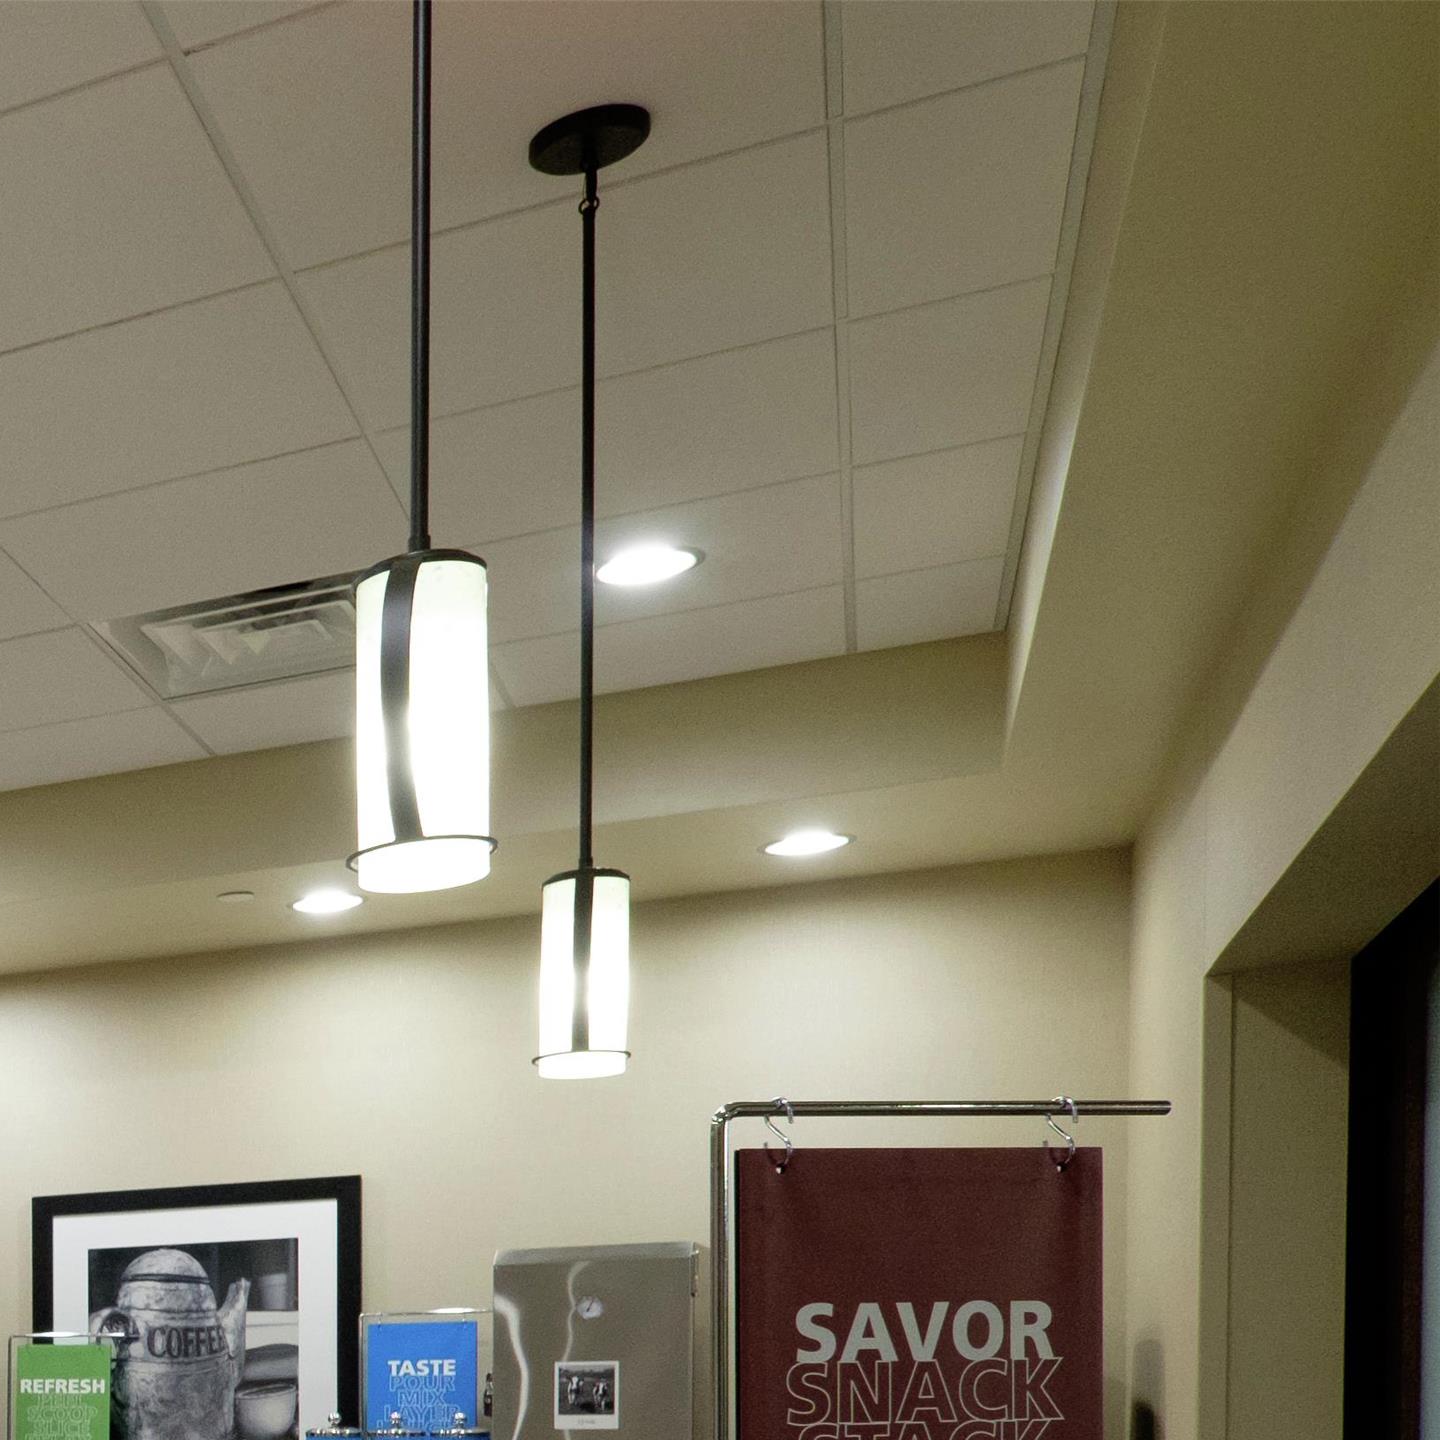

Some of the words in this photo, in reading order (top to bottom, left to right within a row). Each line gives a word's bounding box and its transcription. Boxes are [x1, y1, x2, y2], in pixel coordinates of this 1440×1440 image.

[794, 1300, 1056, 1363] SAVOR
[387, 1359, 457, 1377] TASTE
[20, 1378, 106, 1395] REFRESH
[388, 1375, 457, 1392] POUR
[785, 1356, 1065, 1427] SNACK
[396, 1389, 447, 1408] MIX
[26, 1406, 99, 1424] SCOOP
[32, 1420, 92, 1438] SLICE
